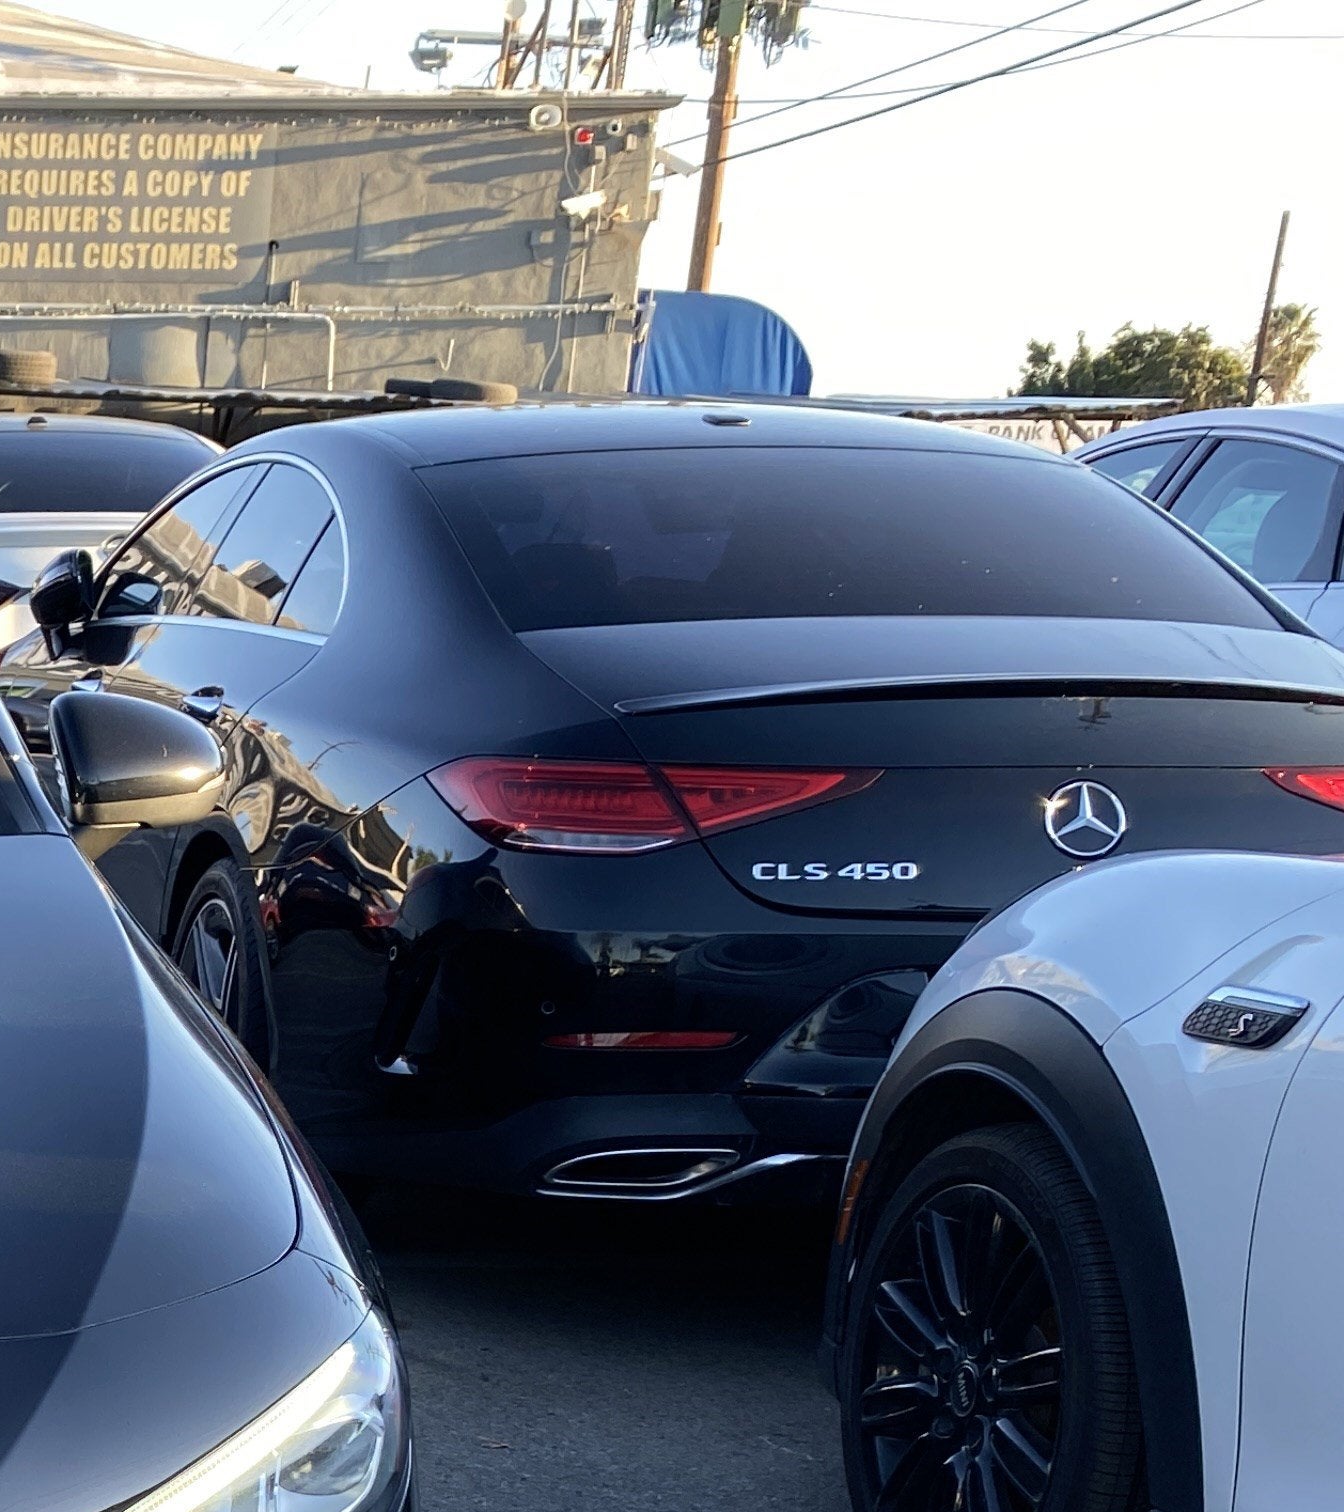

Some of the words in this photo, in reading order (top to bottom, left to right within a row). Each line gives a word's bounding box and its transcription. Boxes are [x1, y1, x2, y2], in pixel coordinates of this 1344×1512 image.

[138, 132, 264, 161] COMPANY
[122, 169, 139, 198] A
[146, 169, 214, 198] COPY
[219, 169, 253, 198] OF
[6, 205, 123, 234] DRIVER'S
[129, 206, 233, 234] LICENSE
[34, 241, 78, 269] ALL
[83, 241, 239, 270] CUSTOMERS
[751, 861, 829, 881] CLS
[836, 861, 920, 881] 450
